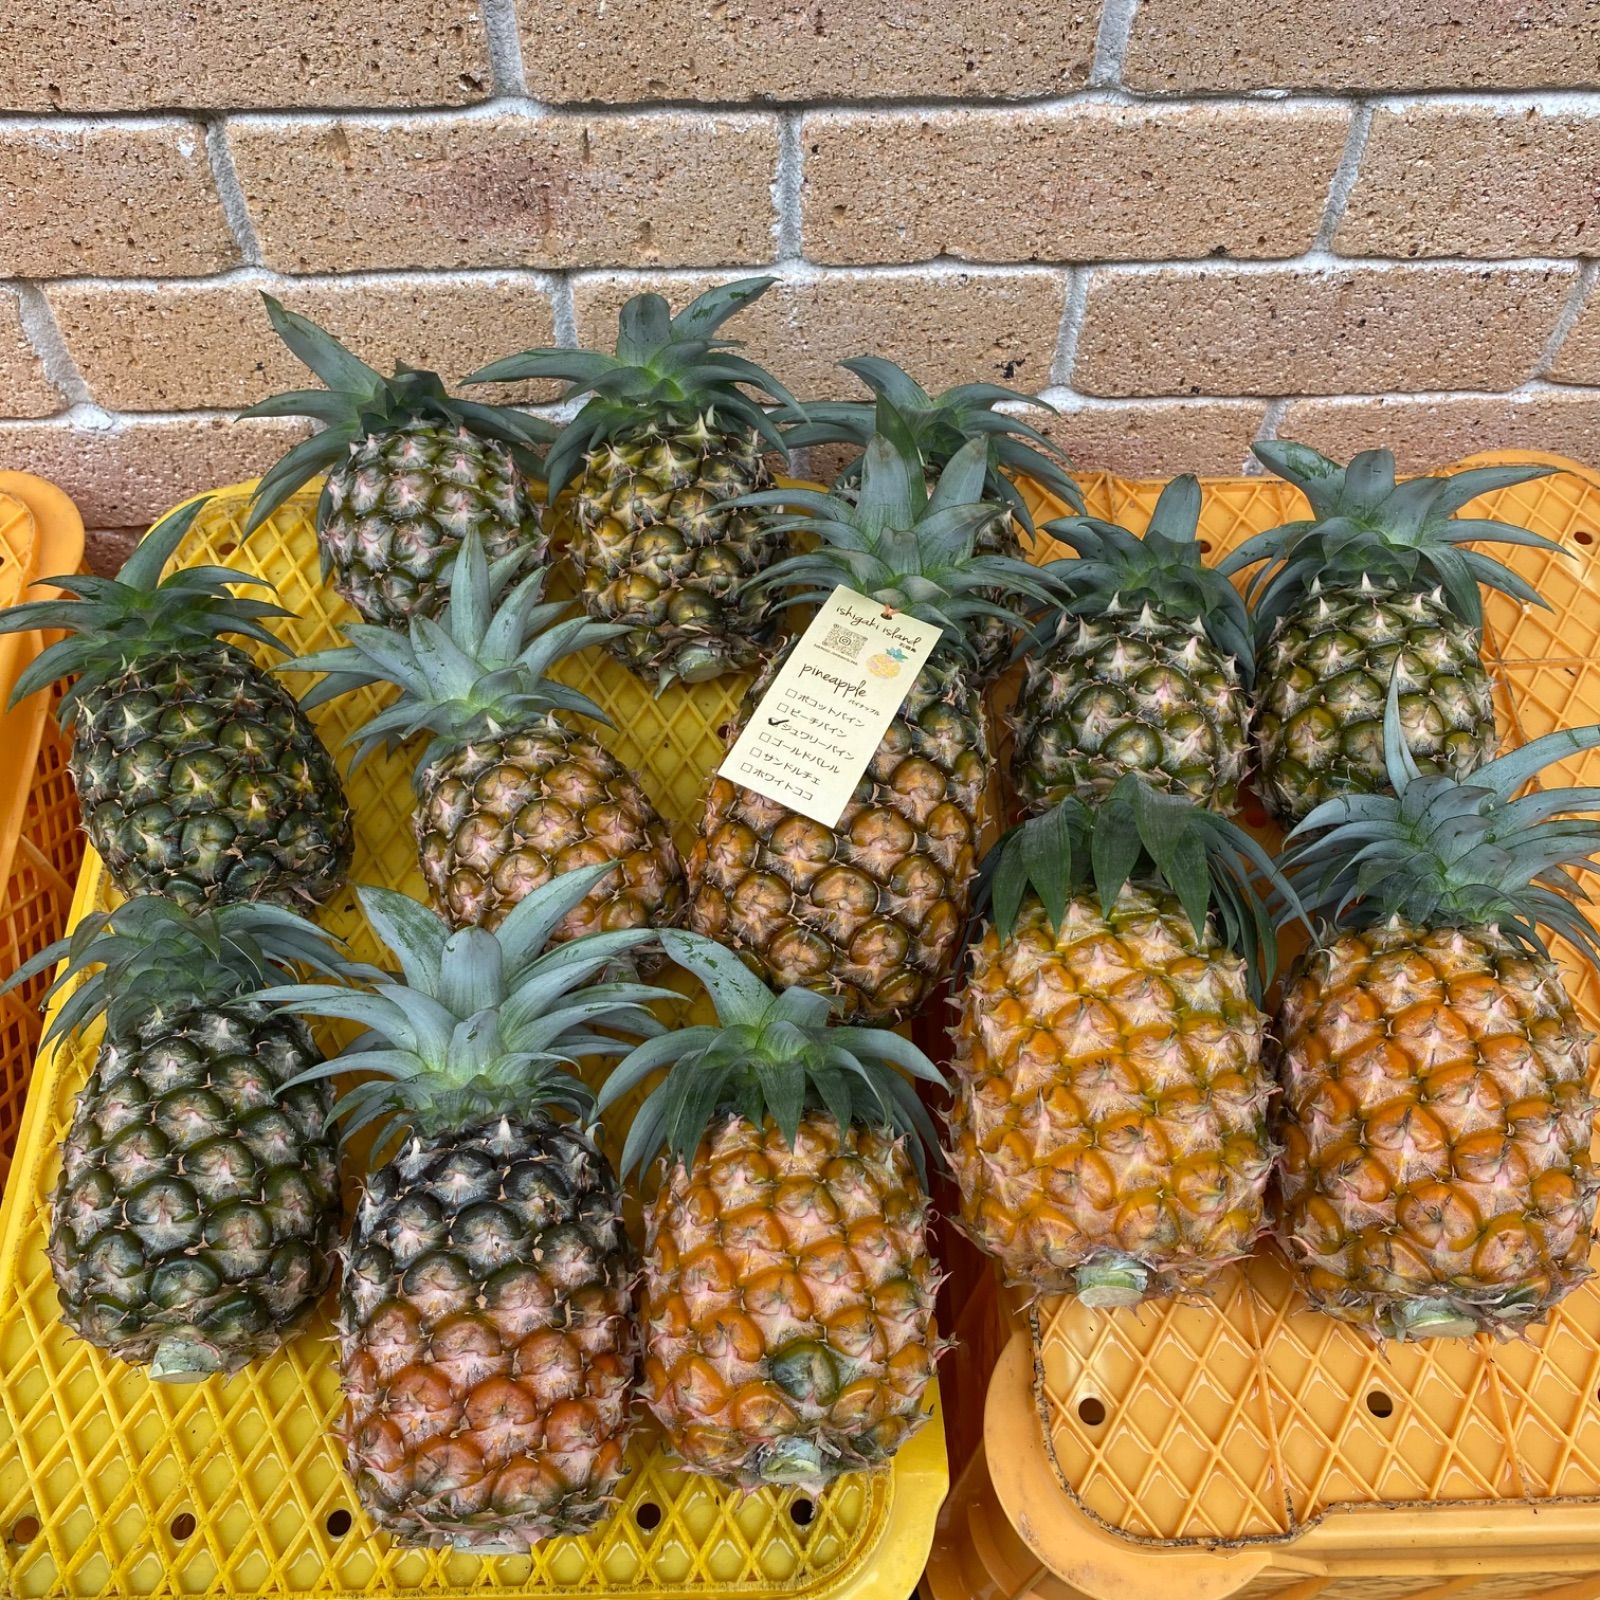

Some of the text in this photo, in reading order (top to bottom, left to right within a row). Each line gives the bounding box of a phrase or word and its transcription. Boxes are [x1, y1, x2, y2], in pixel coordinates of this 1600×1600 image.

[836, 605, 922, 646] ishigaki island
[798, 663, 867, 698] pineapple
[790, 708, 847, 738] ピーチパイン
[781, 723, 855, 760] ジュワリーパイン
[753, 768, 814, 801] ホワイトココ
[763, 753, 821, 785] サンドルチェ
